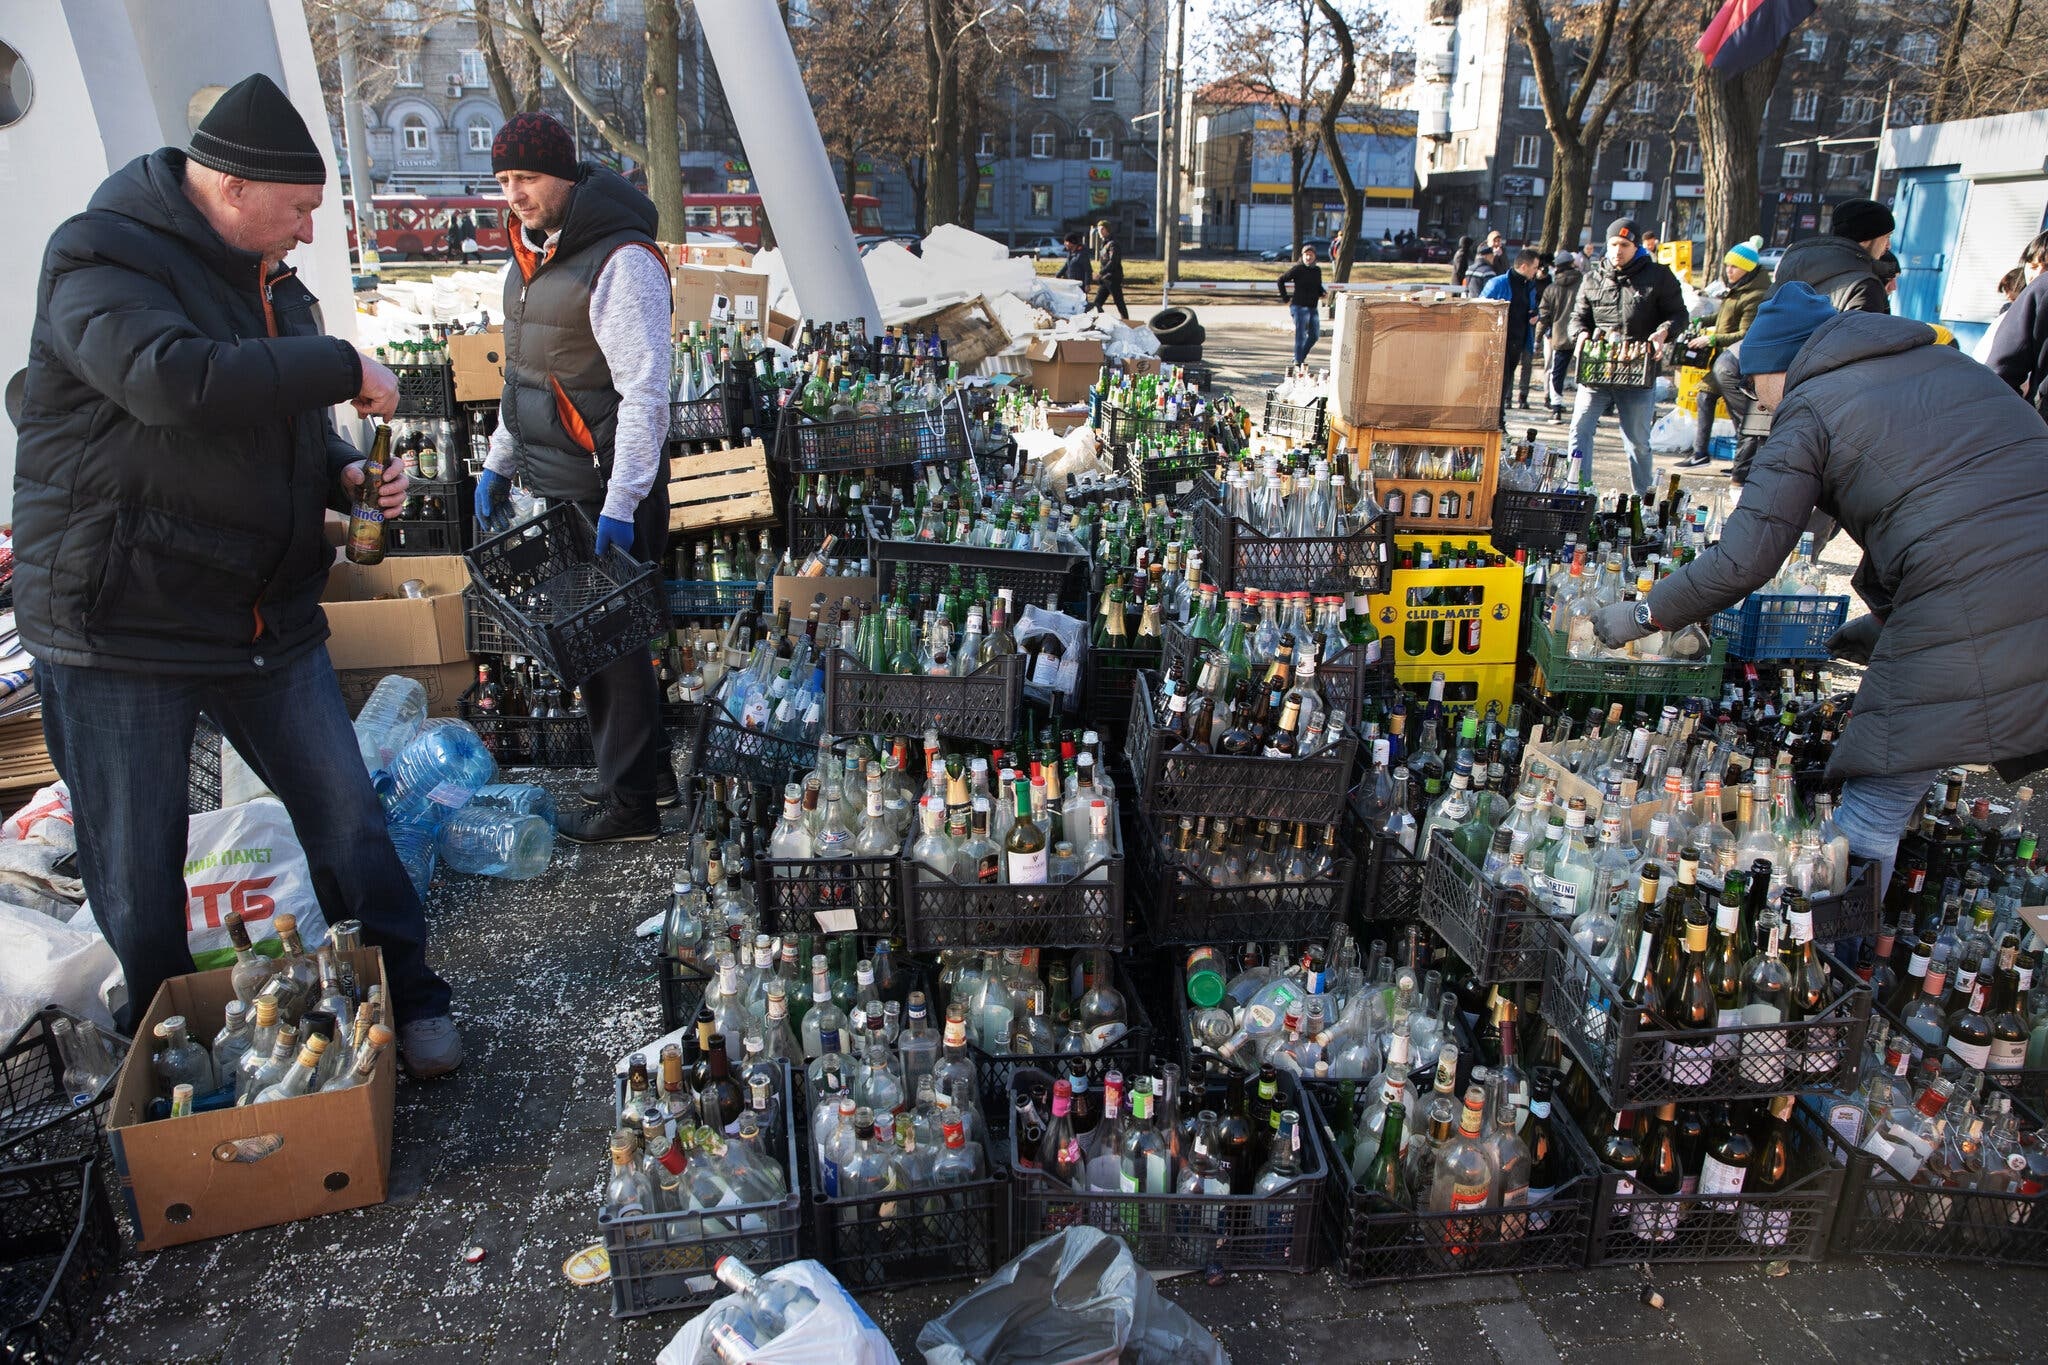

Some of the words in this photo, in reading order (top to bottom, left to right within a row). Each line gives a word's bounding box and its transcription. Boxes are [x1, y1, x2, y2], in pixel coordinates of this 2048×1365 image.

[352, 506, 385, 522] amCo
[1406, 608, 1481, 620] CLUB-MATE
[221, 848, 272, 866] ПАКЕТ
[1549, 881, 1574, 895] ARTINI
[185, 876, 277, 932] ТБ
